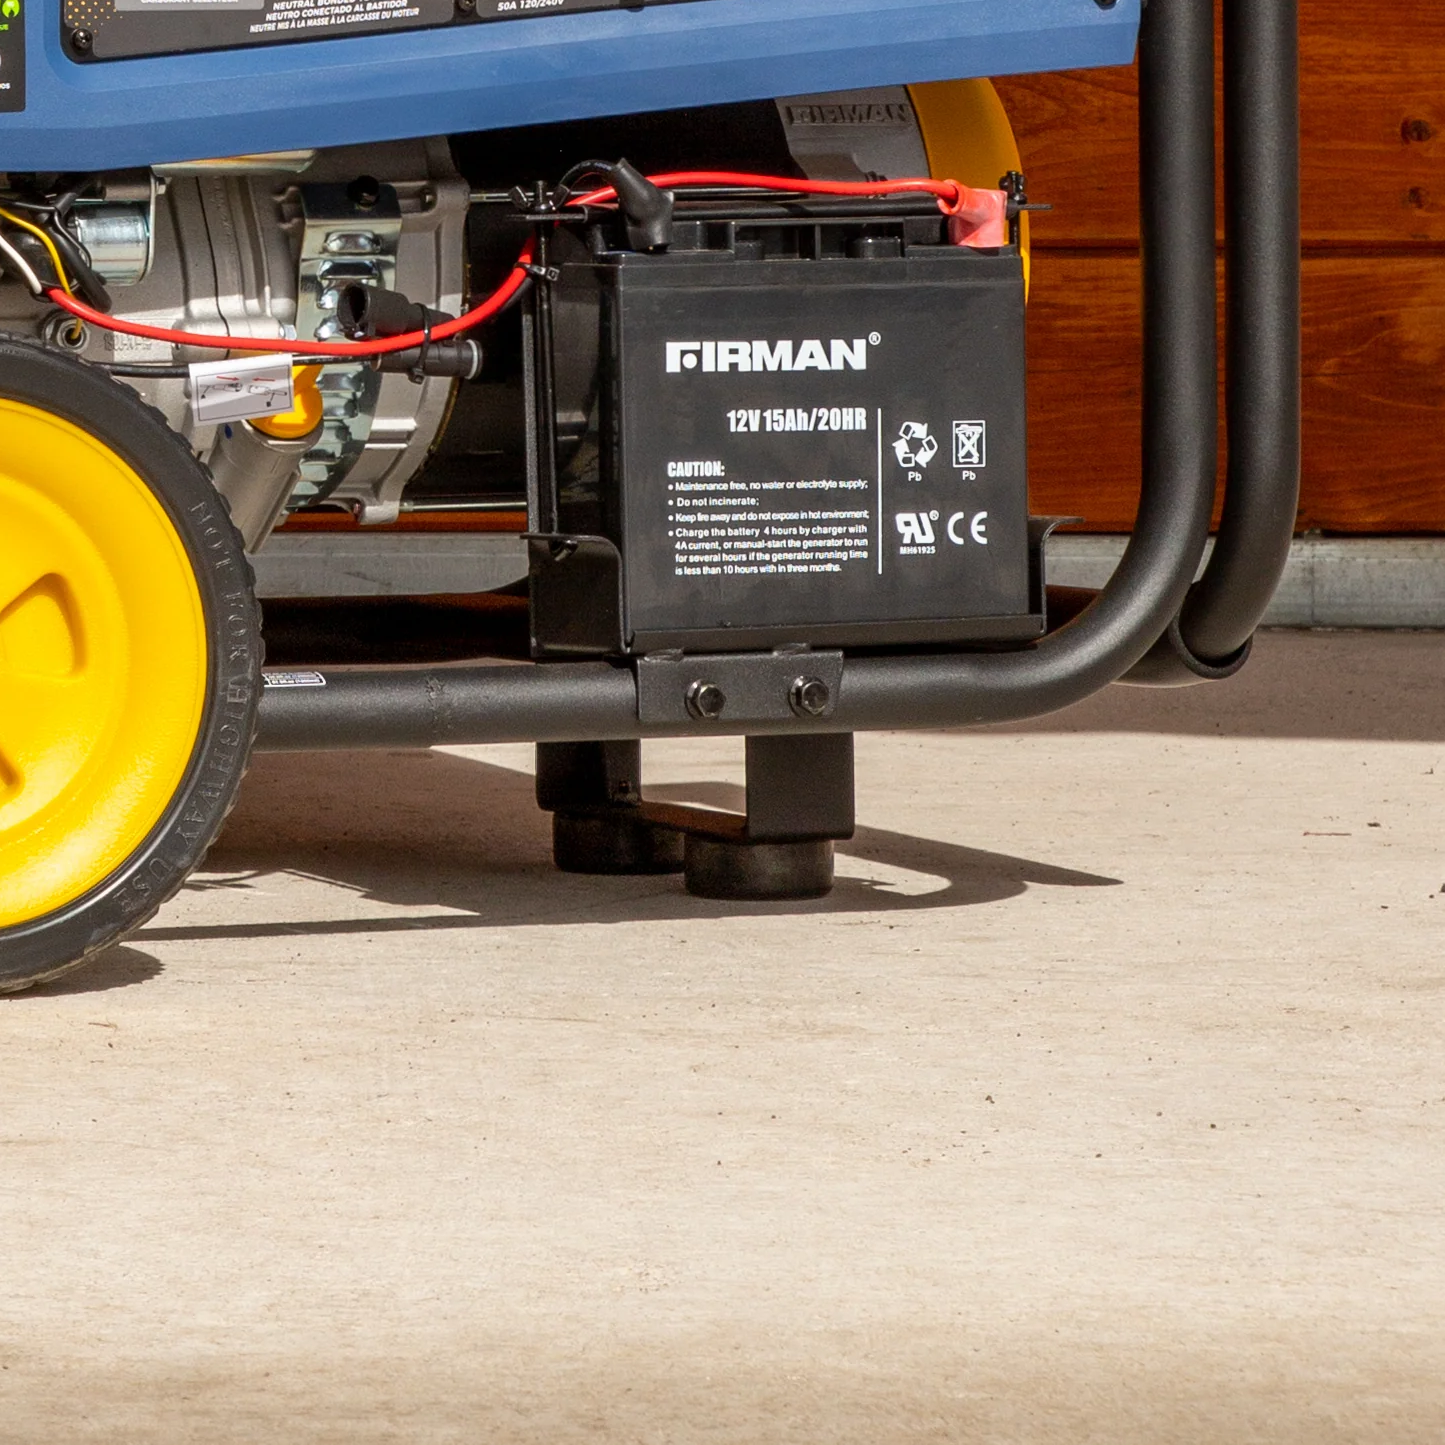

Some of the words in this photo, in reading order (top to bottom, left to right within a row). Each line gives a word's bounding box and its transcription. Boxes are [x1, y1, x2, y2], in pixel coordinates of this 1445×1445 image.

[273, 0, 315, 10] NEUTRAL
[497, 0, 517, 11] 50A
[266, 11, 299, 21] NEUTRO
[302, 6, 352, 18] CONECTADO
[354, 4, 364, 12] AL
[366, 0, 407, 11] BASTIDOR
[727, 409, 760, 432] 12V
[765, 408, 867, 431] 15Ah/20HR
[668, 461, 725, 477] CAUTION:
[908, 471, 922, 481] Pb
[962, 470, 976, 480] Pb
[750, 482, 760, 490] no
[762, 482, 785, 490] water
[677, 497, 690, 506] Do
[692, 497, 707, 506] not
[676, 528, 709, 538] Charge
[711, 528, 725, 537] the
[728, 527, 760, 538] battery
[764, 527, 770, 536] 4
[772, 527, 798, 535] hours
[799, 526, 810, 536] by
[812, 525, 847, 536] charger
[849, 525, 867, 534] with
[947, 511, 988, 545] CE
[788, 539, 801, 548] the
[803, 538, 843, 548] generator
[844, 538, 853, 547] to
[675, 567, 683, 575] is
[684, 566, 701, 575] less
[703, 565, 721, 574] than
[724, 565, 733, 574] 10
[735, 565, 758, 574] hours
